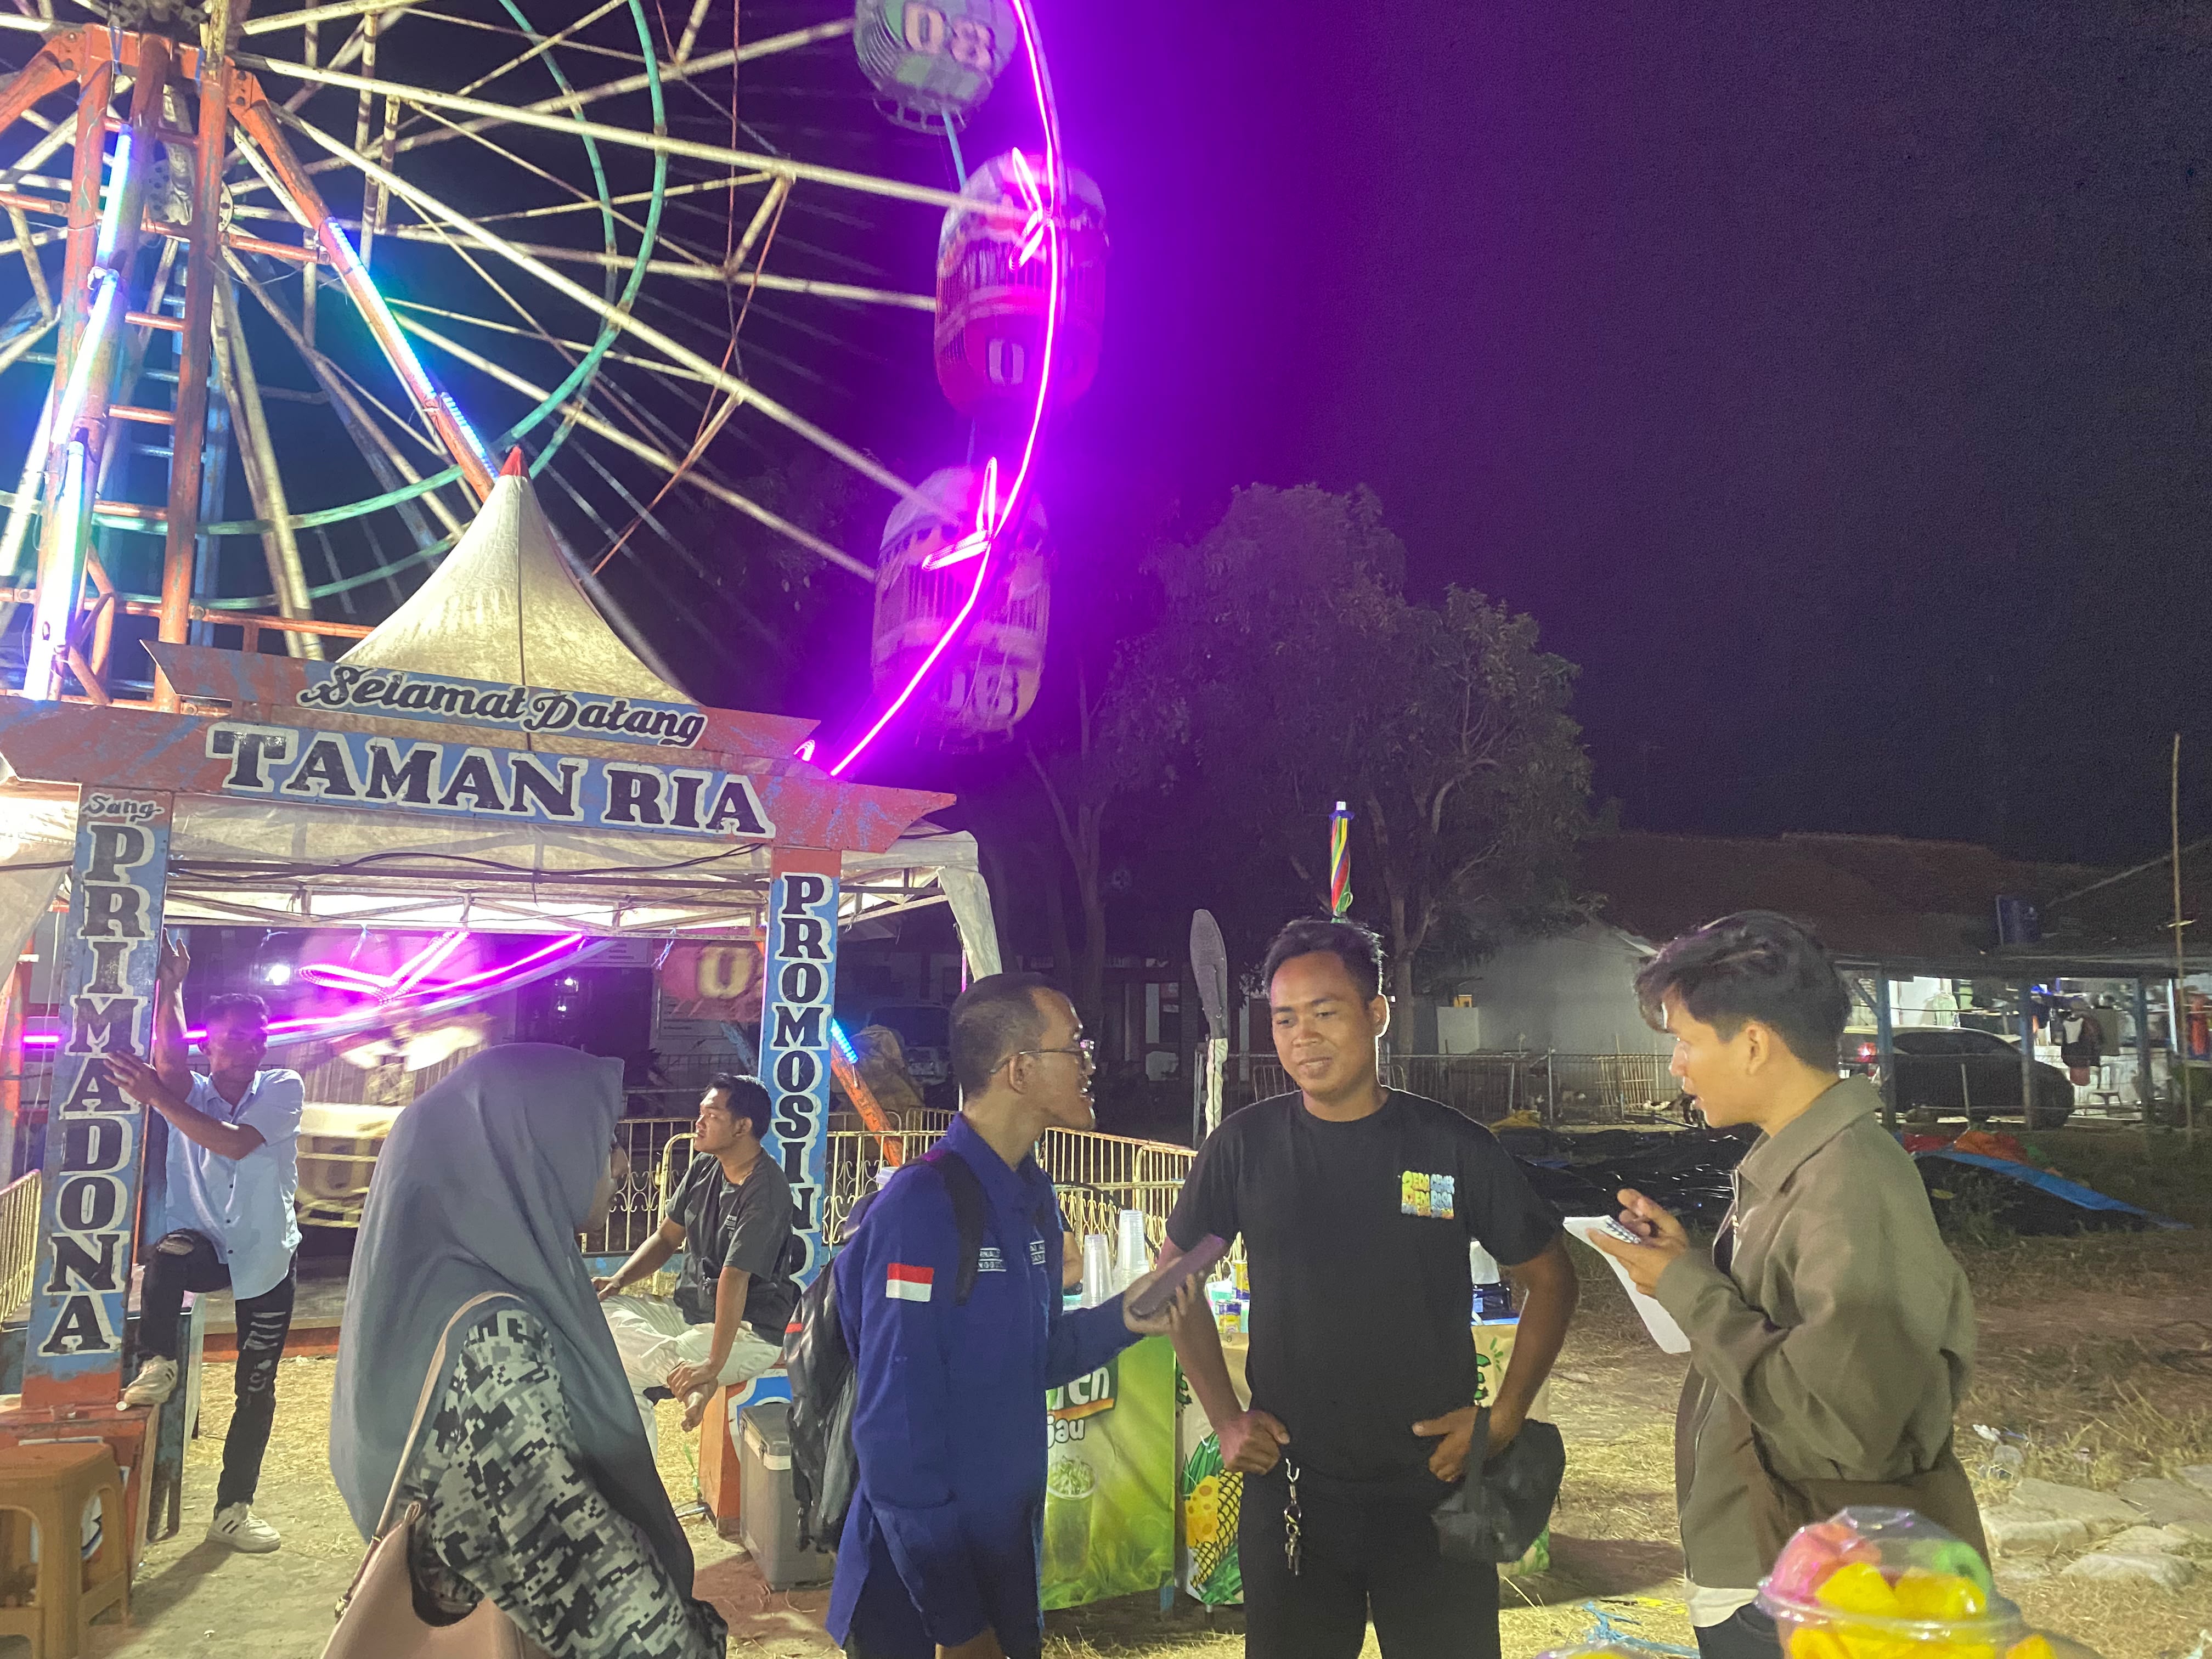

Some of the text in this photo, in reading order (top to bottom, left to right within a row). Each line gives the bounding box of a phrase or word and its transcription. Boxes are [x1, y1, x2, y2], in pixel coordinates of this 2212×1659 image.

[298, 664, 707, 748] Selamat Datang
[82, 793, 163, 822] Sang
[207, 723, 775, 838] TAMAN RIA
[38, 823, 154, 1356] PRIMADONA
[771, 873, 833, 1308] PROMOSIN
